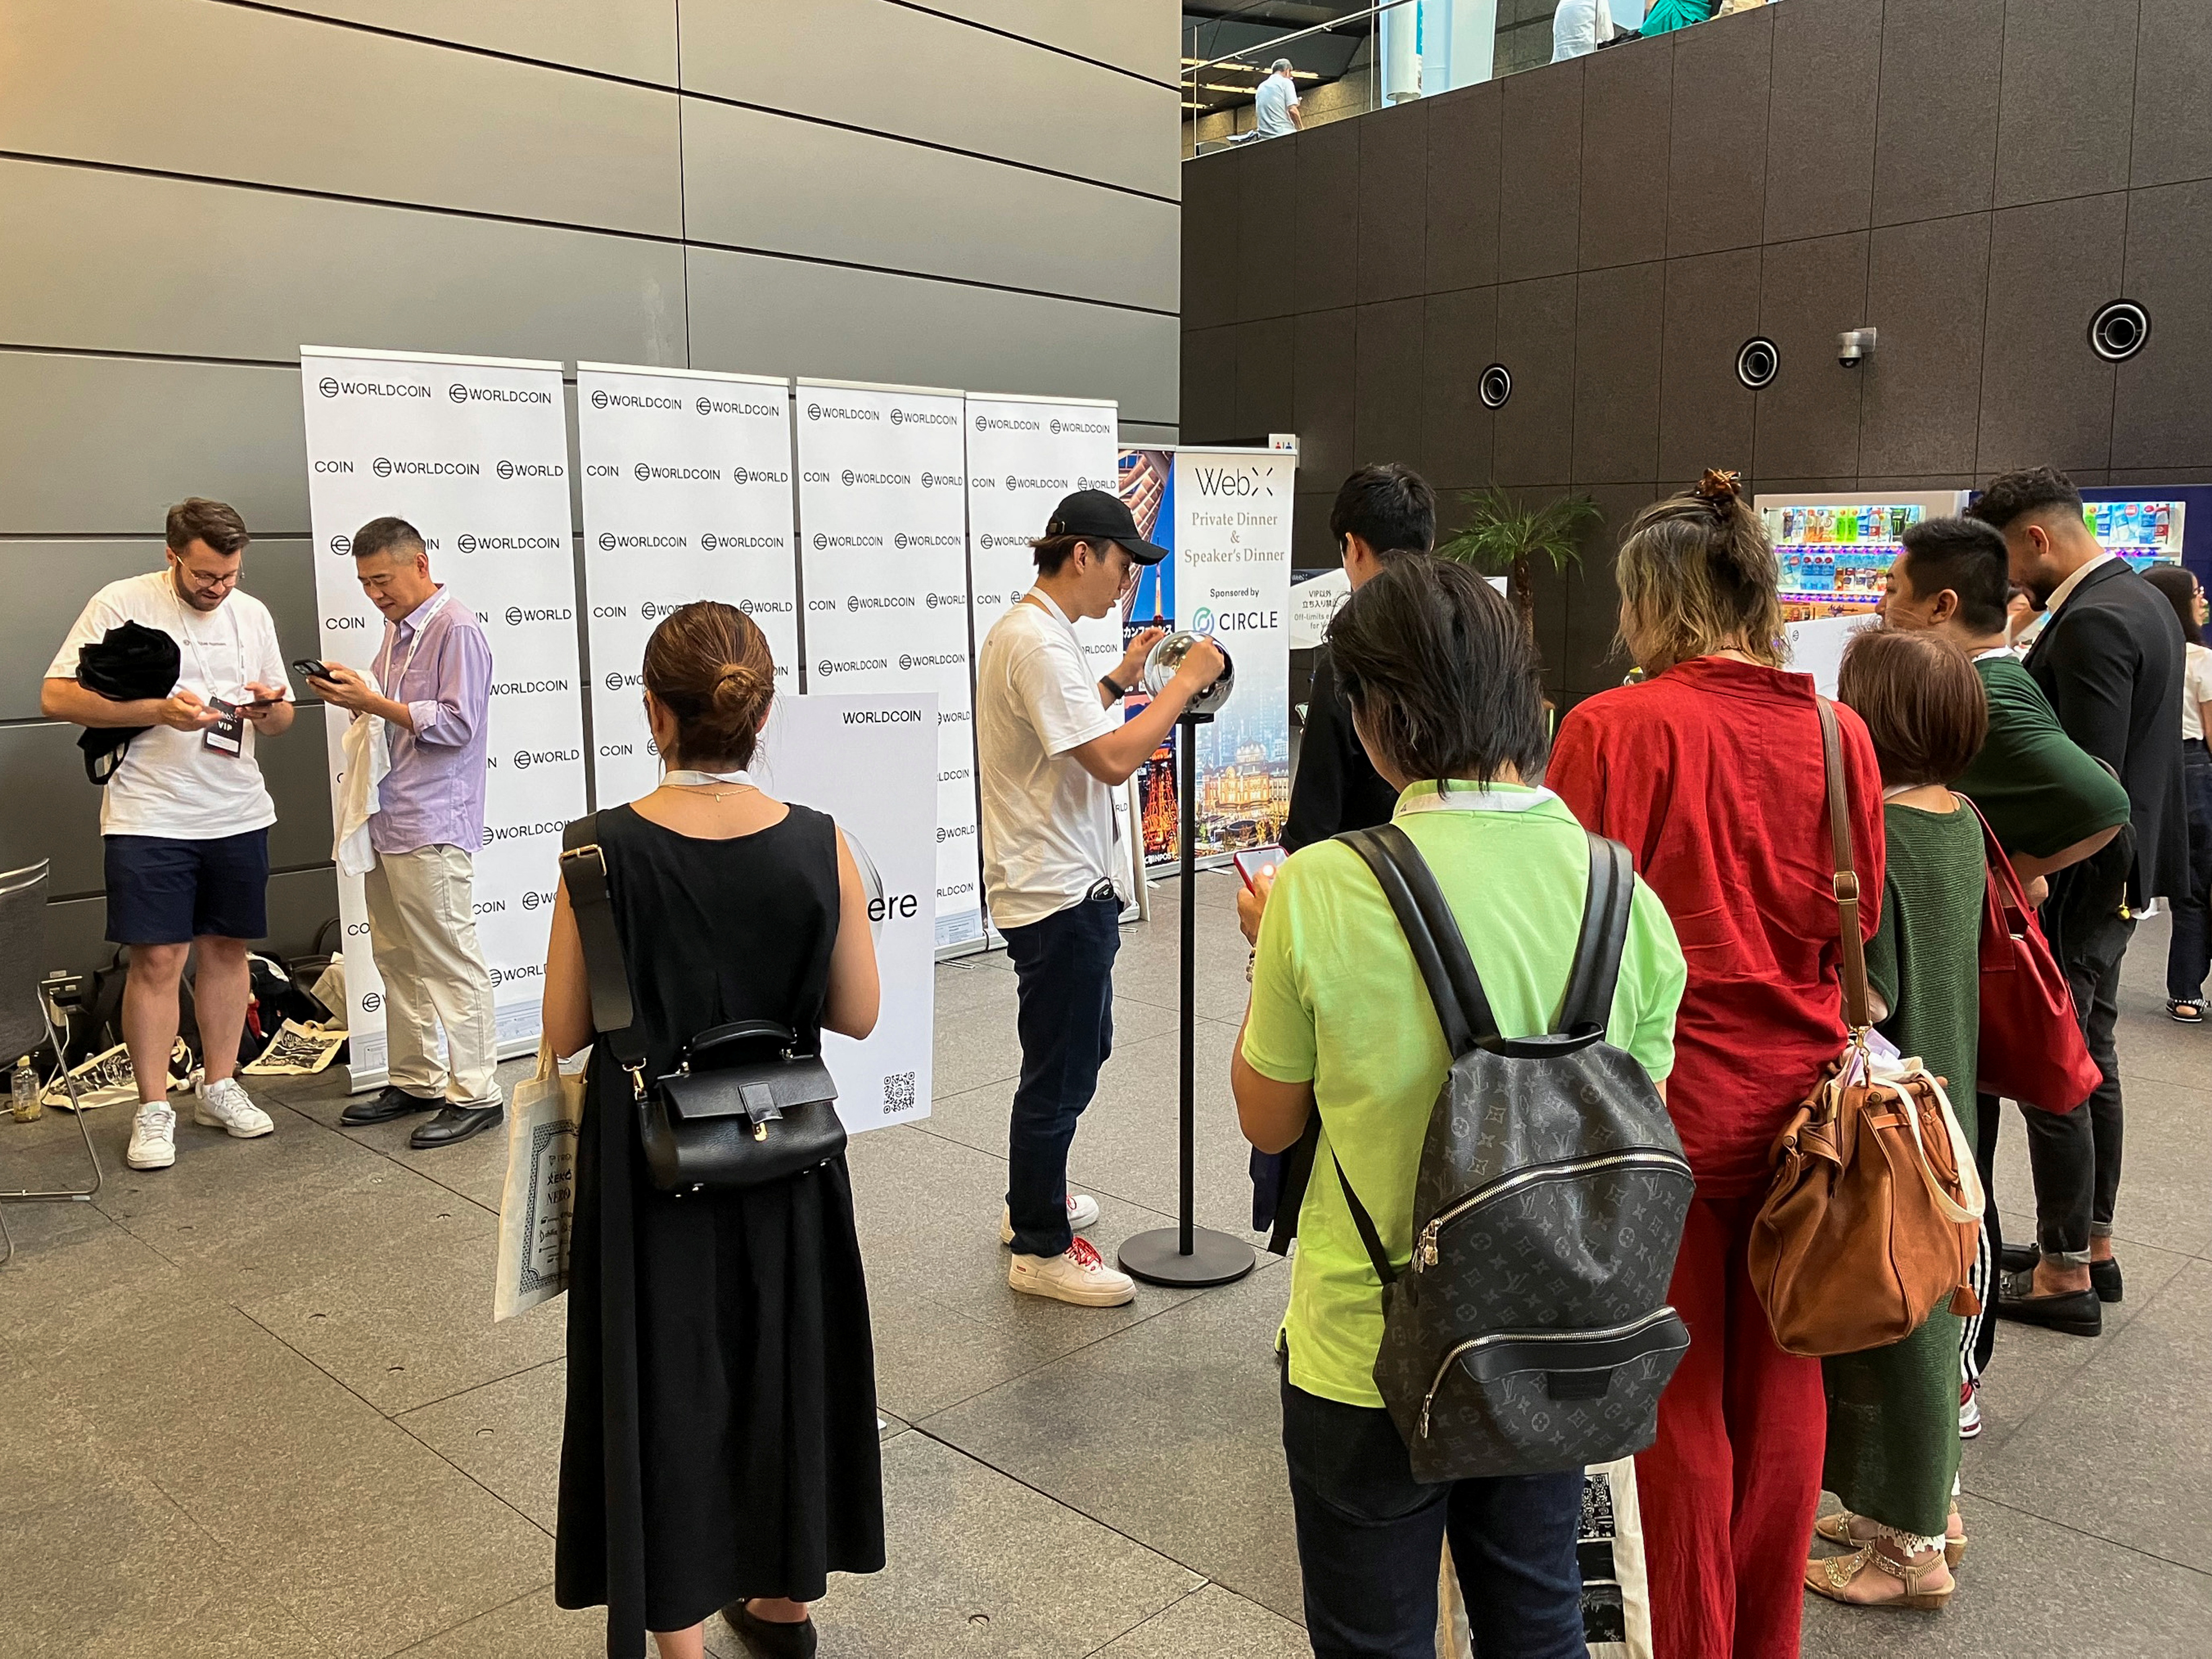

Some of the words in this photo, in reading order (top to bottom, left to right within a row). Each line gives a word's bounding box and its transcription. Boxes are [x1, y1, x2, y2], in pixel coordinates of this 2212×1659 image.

[341, 382, 430, 397] WORLDCOIN
[469, 389, 551, 403] WORLDCOIN
[610, 395, 681, 409] WORLDCOIN
[713, 402, 779, 416] WORLDCOIN
[822, 408, 879, 420] WORLDCOIN
[904, 413, 957, 425] WORLDCOIN
[988, 420, 1039, 430] WORLDCOIN
[1062, 423, 1109, 433] WORLDCOIN
[315, 461, 353, 473] COIN
[394, 463, 479, 475] WORLDCOIN
[515, 465, 563, 476] WORLD
[587, 466, 619, 476] COIN
[652, 467, 720, 480] WORLDCOIN
[749, 471, 787, 482] WORLD
[804, 473, 829, 482] COIN
[855, 474, 910, 484] WORLDCOIN
[934, 475, 962, 486] WORLD
[972, 479, 995, 487] COIN
[1018, 479, 1067, 488] WORLDCOIN
[1195, 467, 1273, 496] WebX
[1192, 512, 1233, 526] Private
[1238, 512, 1277, 526] Dinner
[617, 537, 686, 547] WORLDCOIN
[718, 537, 783, 547] WORLDCOIN
[829, 537, 882, 546] WORLDCOIN
[909, 537, 960, 545] WORLDCOIN
[994, 536, 1041, 545] WORLDC
[1231, 530, 1240, 543] &
[478, 538, 559, 549] WORLDCOIN
[1244, 548, 1285, 562] Dinner
[1210, 588, 1248, 598] Sponsored
[1250, 587, 1259, 598] by
[809, 600, 835, 610] COIN
[859, 597, 915, 609] WORLDCOIN
[939, 595, 965, 605] WORLD
[977, 595, 1000, 604] COIN
[594, 607, 626, 617] COIN
[754, 602, 792, 612] WORLD
[326, 617, 364, 629] COIN
[524, 609, 571, 621] WORLD
[1219, 611, 1278, 631] CIRCLE
[1082, 644, 1117, 654] RLDCOIN
[834, 659, 887, 672] WORLDCOIN
[913, 654, 964, 666] WORLDCOIN
[843, 710, 921, 724] WORLDCOIN
[943, 711, 970, 723] WORLD
[218, 721, 232, 731] VIP
[532, 750, 579, 763] WORLD
[600, 744, 632, 756] COIN
[937, 769, 969, 782] LDCOIN
[1116, 803, 1127, 812] RLD
[947, 825, 974, 838] WORLD
[937, 883, 973, 897] RLDCOIN
[868, 894, 917, 921] ere
[348, 922, 370, 935] CO
